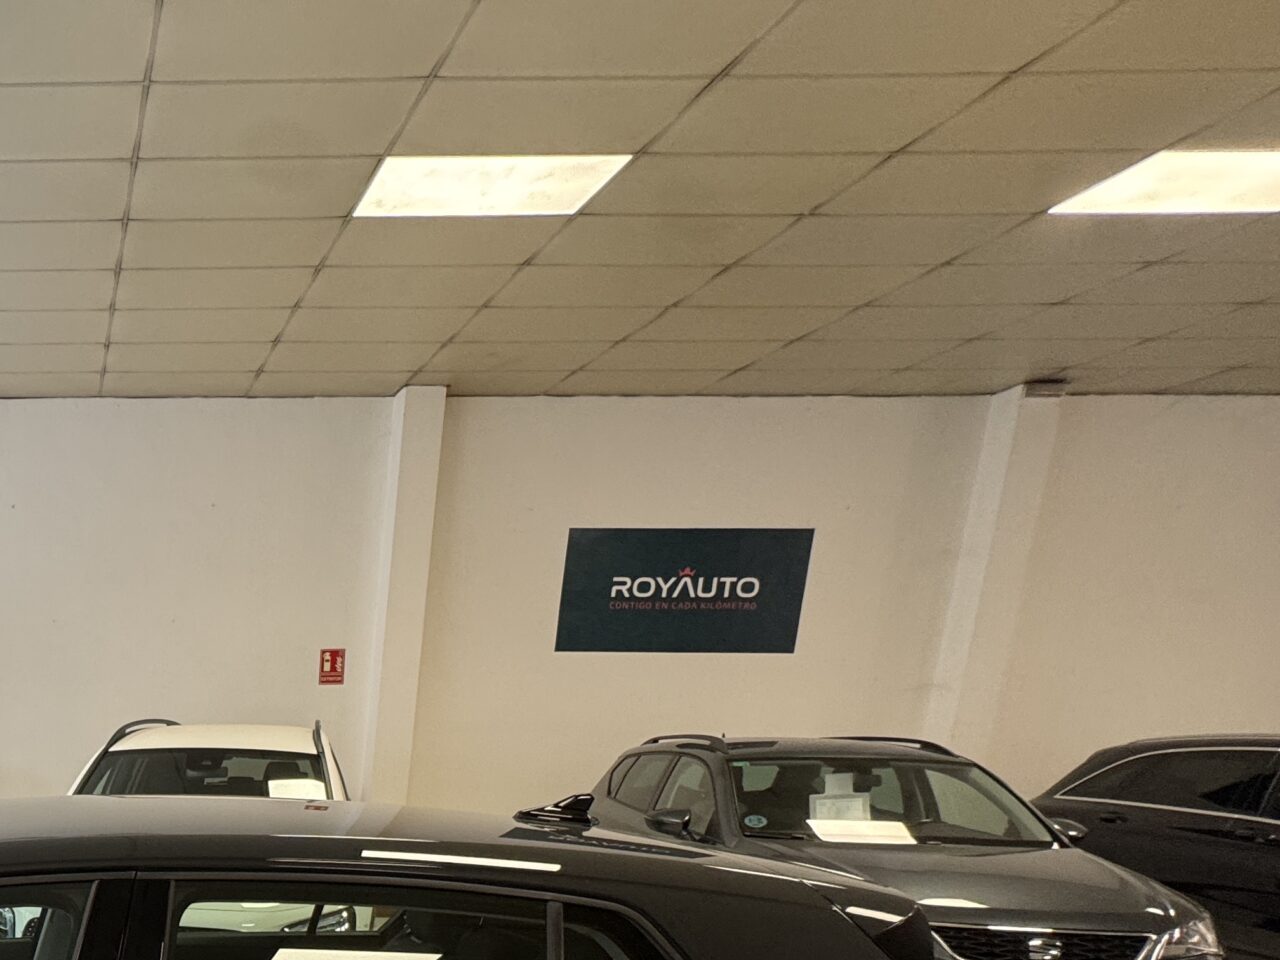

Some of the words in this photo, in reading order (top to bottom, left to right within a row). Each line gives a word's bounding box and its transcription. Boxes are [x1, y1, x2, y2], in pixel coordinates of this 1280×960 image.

[610, 576, 760, 598] ROYAUTO
[609, 601, 652, 610] CONTIGO
[656, 601, 669, 610] EN
[672, 601, 697, 610] CADA
